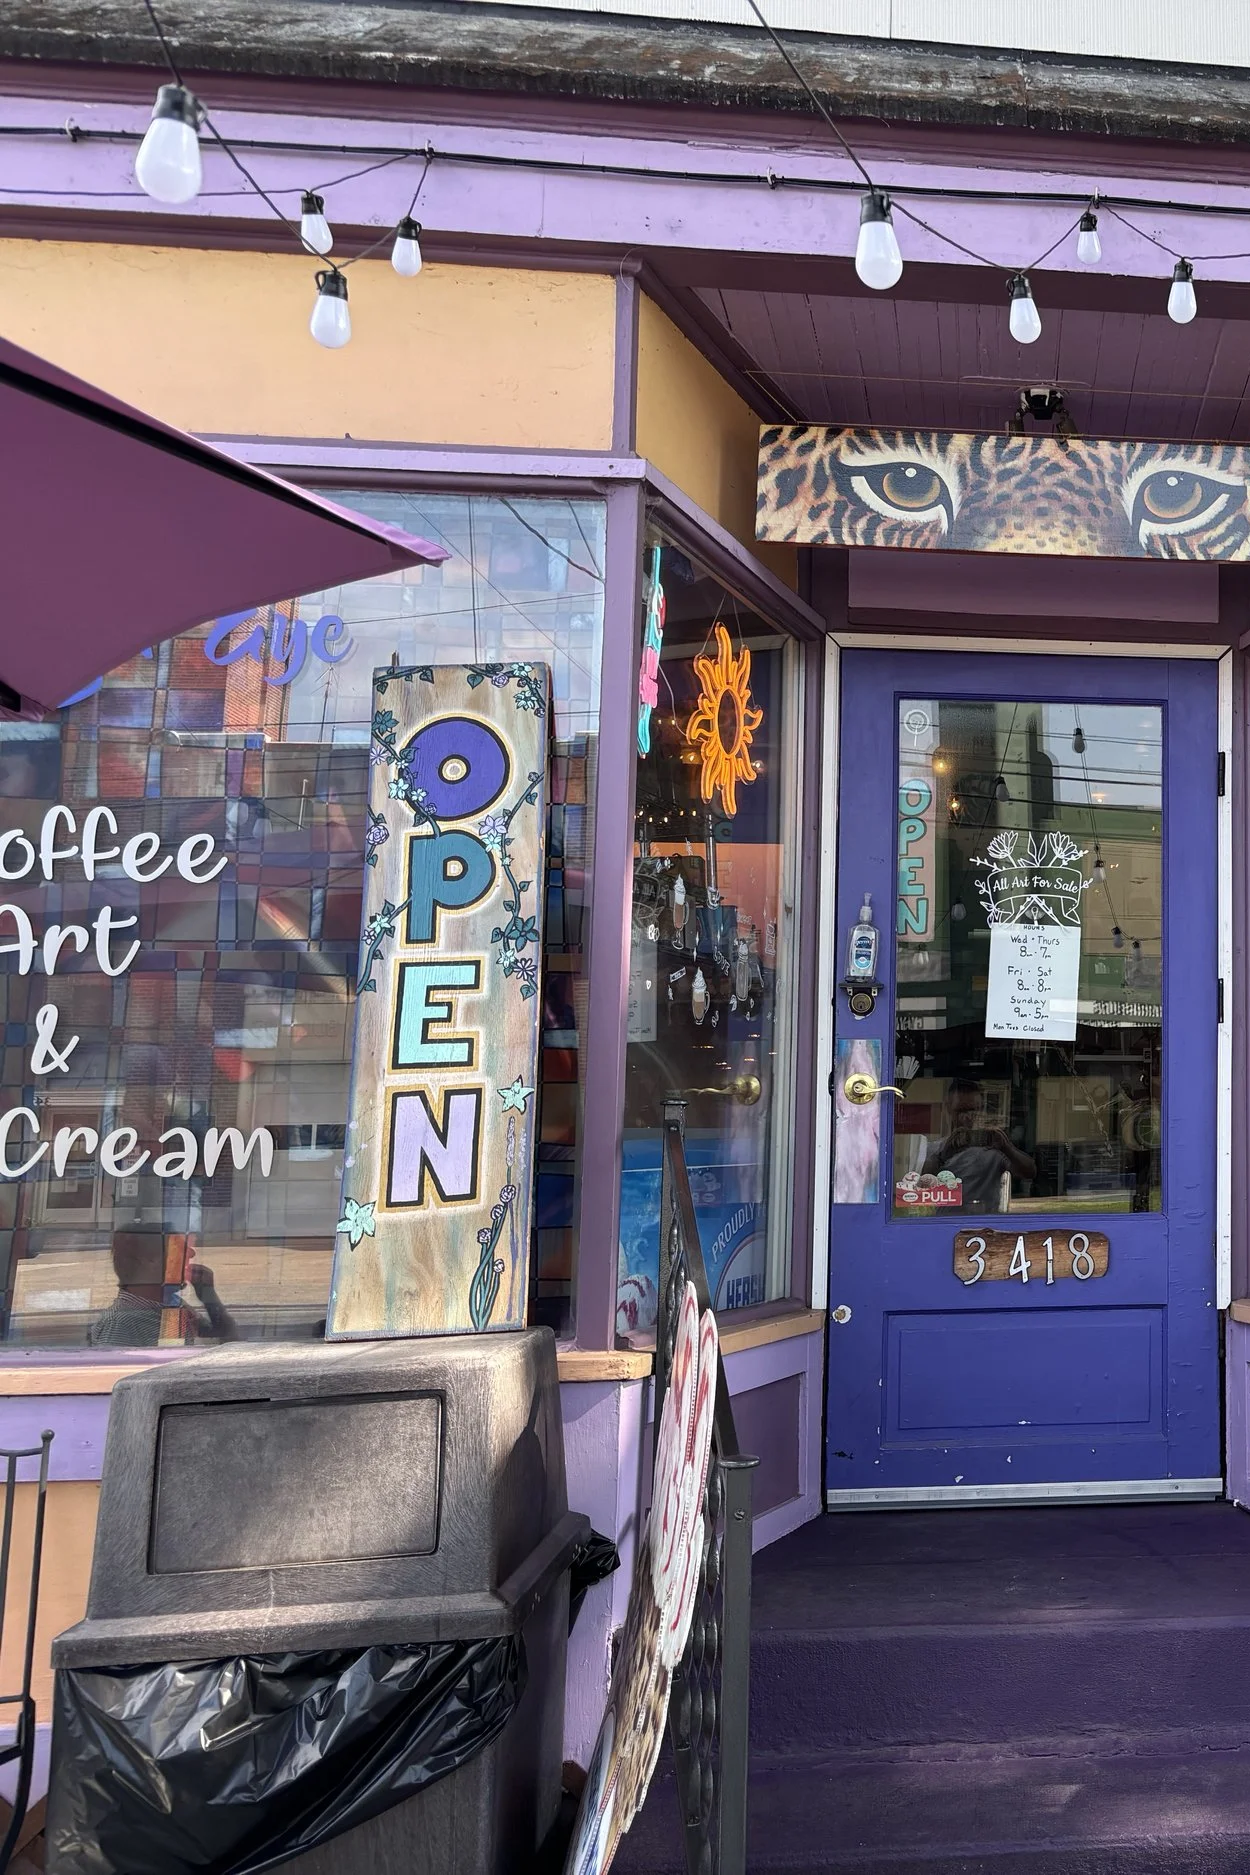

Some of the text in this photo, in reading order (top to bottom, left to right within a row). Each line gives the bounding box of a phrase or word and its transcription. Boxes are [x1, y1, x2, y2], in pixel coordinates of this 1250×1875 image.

[897, 779, 932, 936] OPEN
[993, 875, 1080, 893] All Art For Sale
[1010, 935, 1060, 946] Wed Thurs
[386, 717, 511, 1209] OPEN
[1007, 965, 1053, 977] Fri Sat
[1010, 996, 1046, 1008] Sunday
[30, 1003, 80, 1074] &
[1023, 1024, 1045, 1032] Closed
[0, 1106, 275, 1180] Cream
[922, 1191, 957, 1203] PULL
[712, 1203, 755, 1263] PROUDLY
[963, 1233, 1095, 1285] 3418
